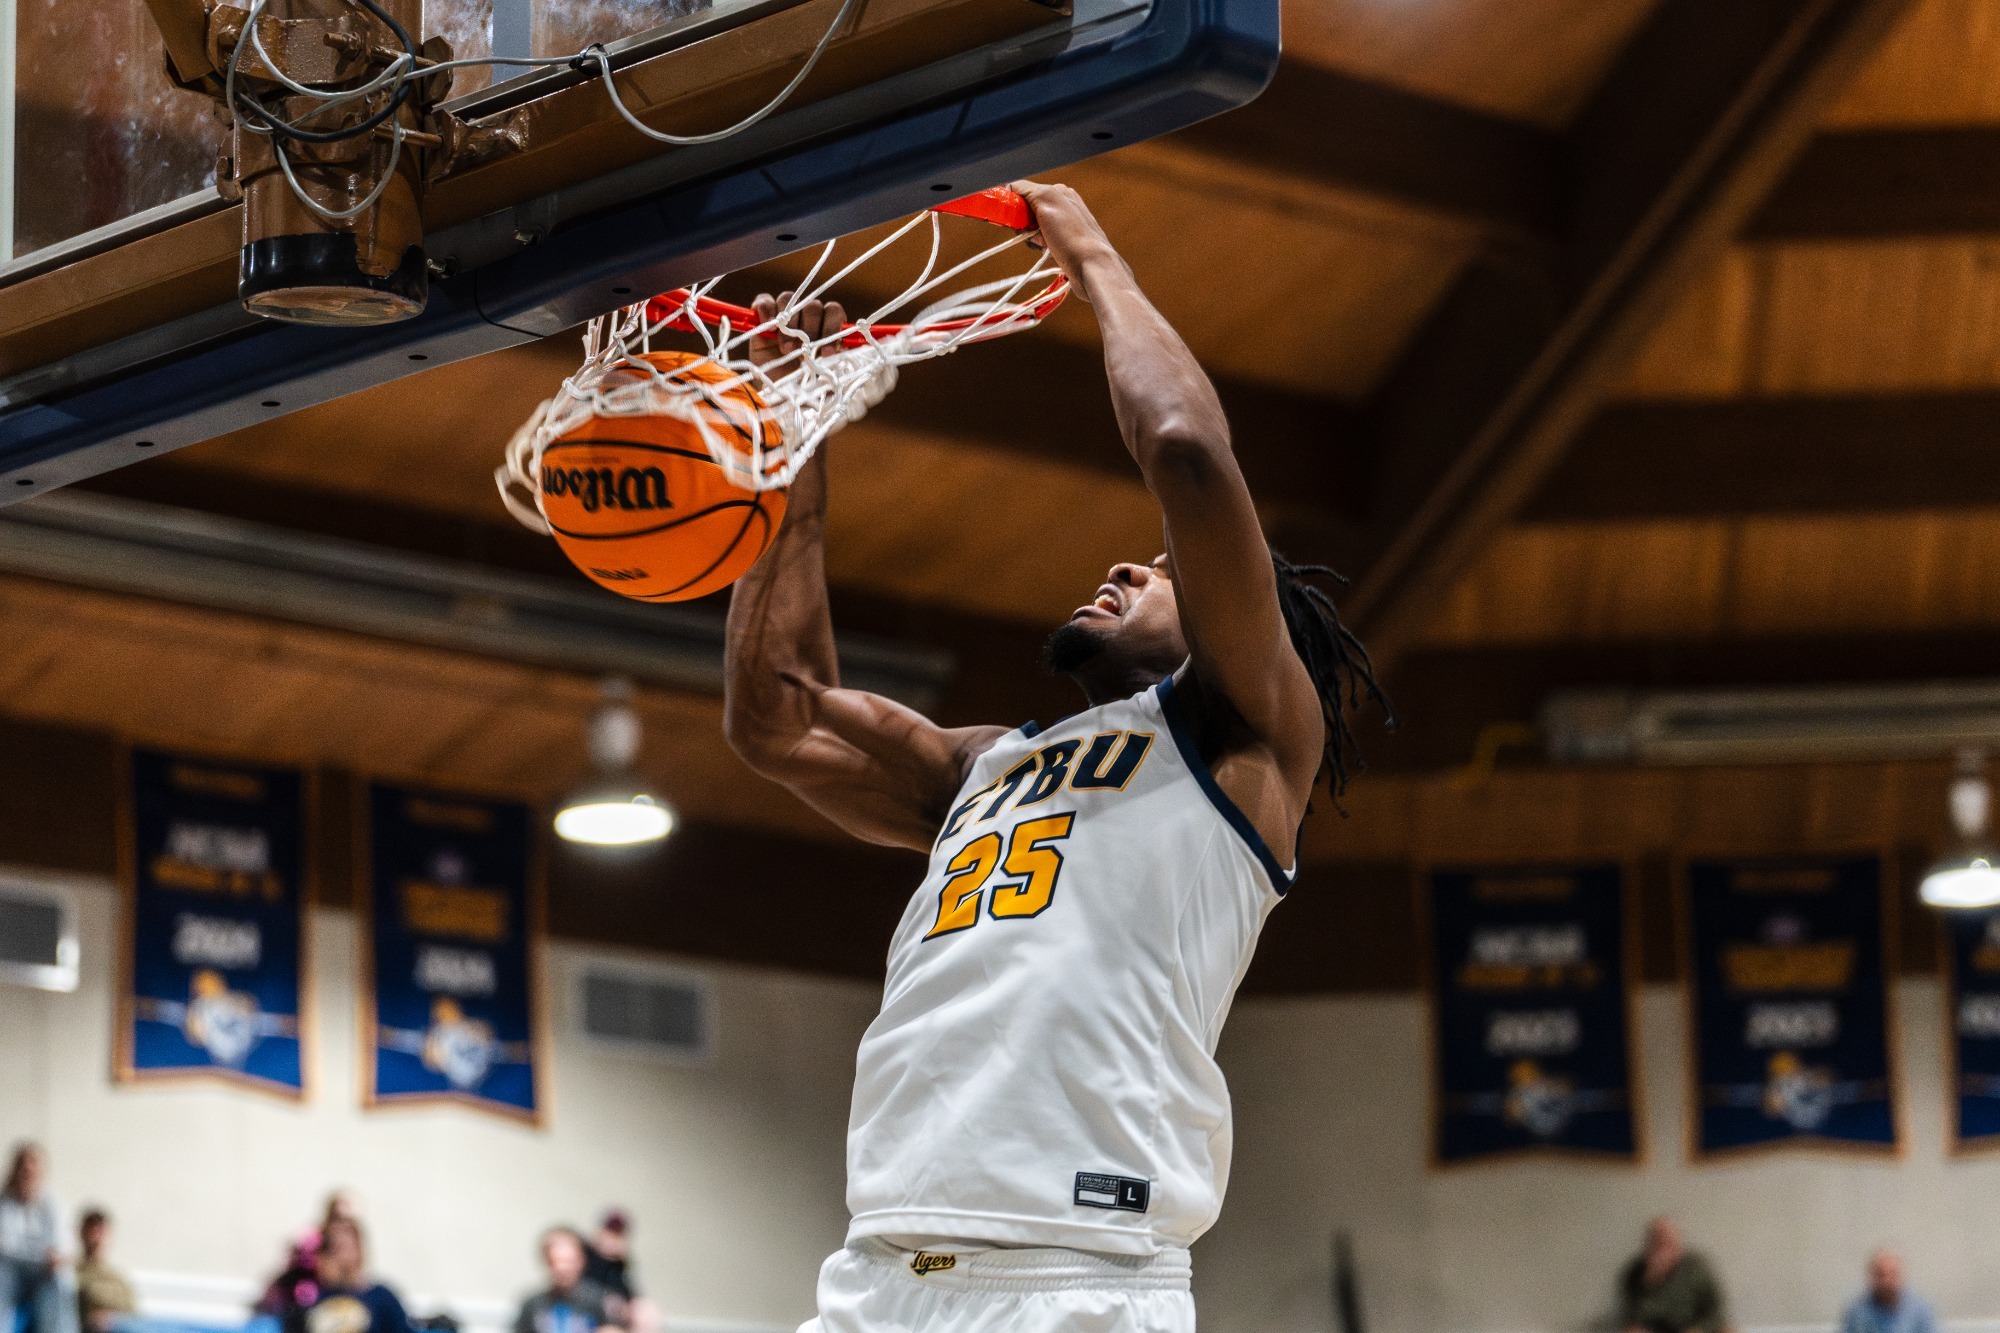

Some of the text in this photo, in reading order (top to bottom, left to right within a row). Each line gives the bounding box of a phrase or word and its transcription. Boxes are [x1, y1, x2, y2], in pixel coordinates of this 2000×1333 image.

[934, 730, 1155, 857] ETBU
[921, 811, 1077, 943] 25
[1126, 1186, 1137, 1201] L
[910, 1250, 957, 1276] Tigers
